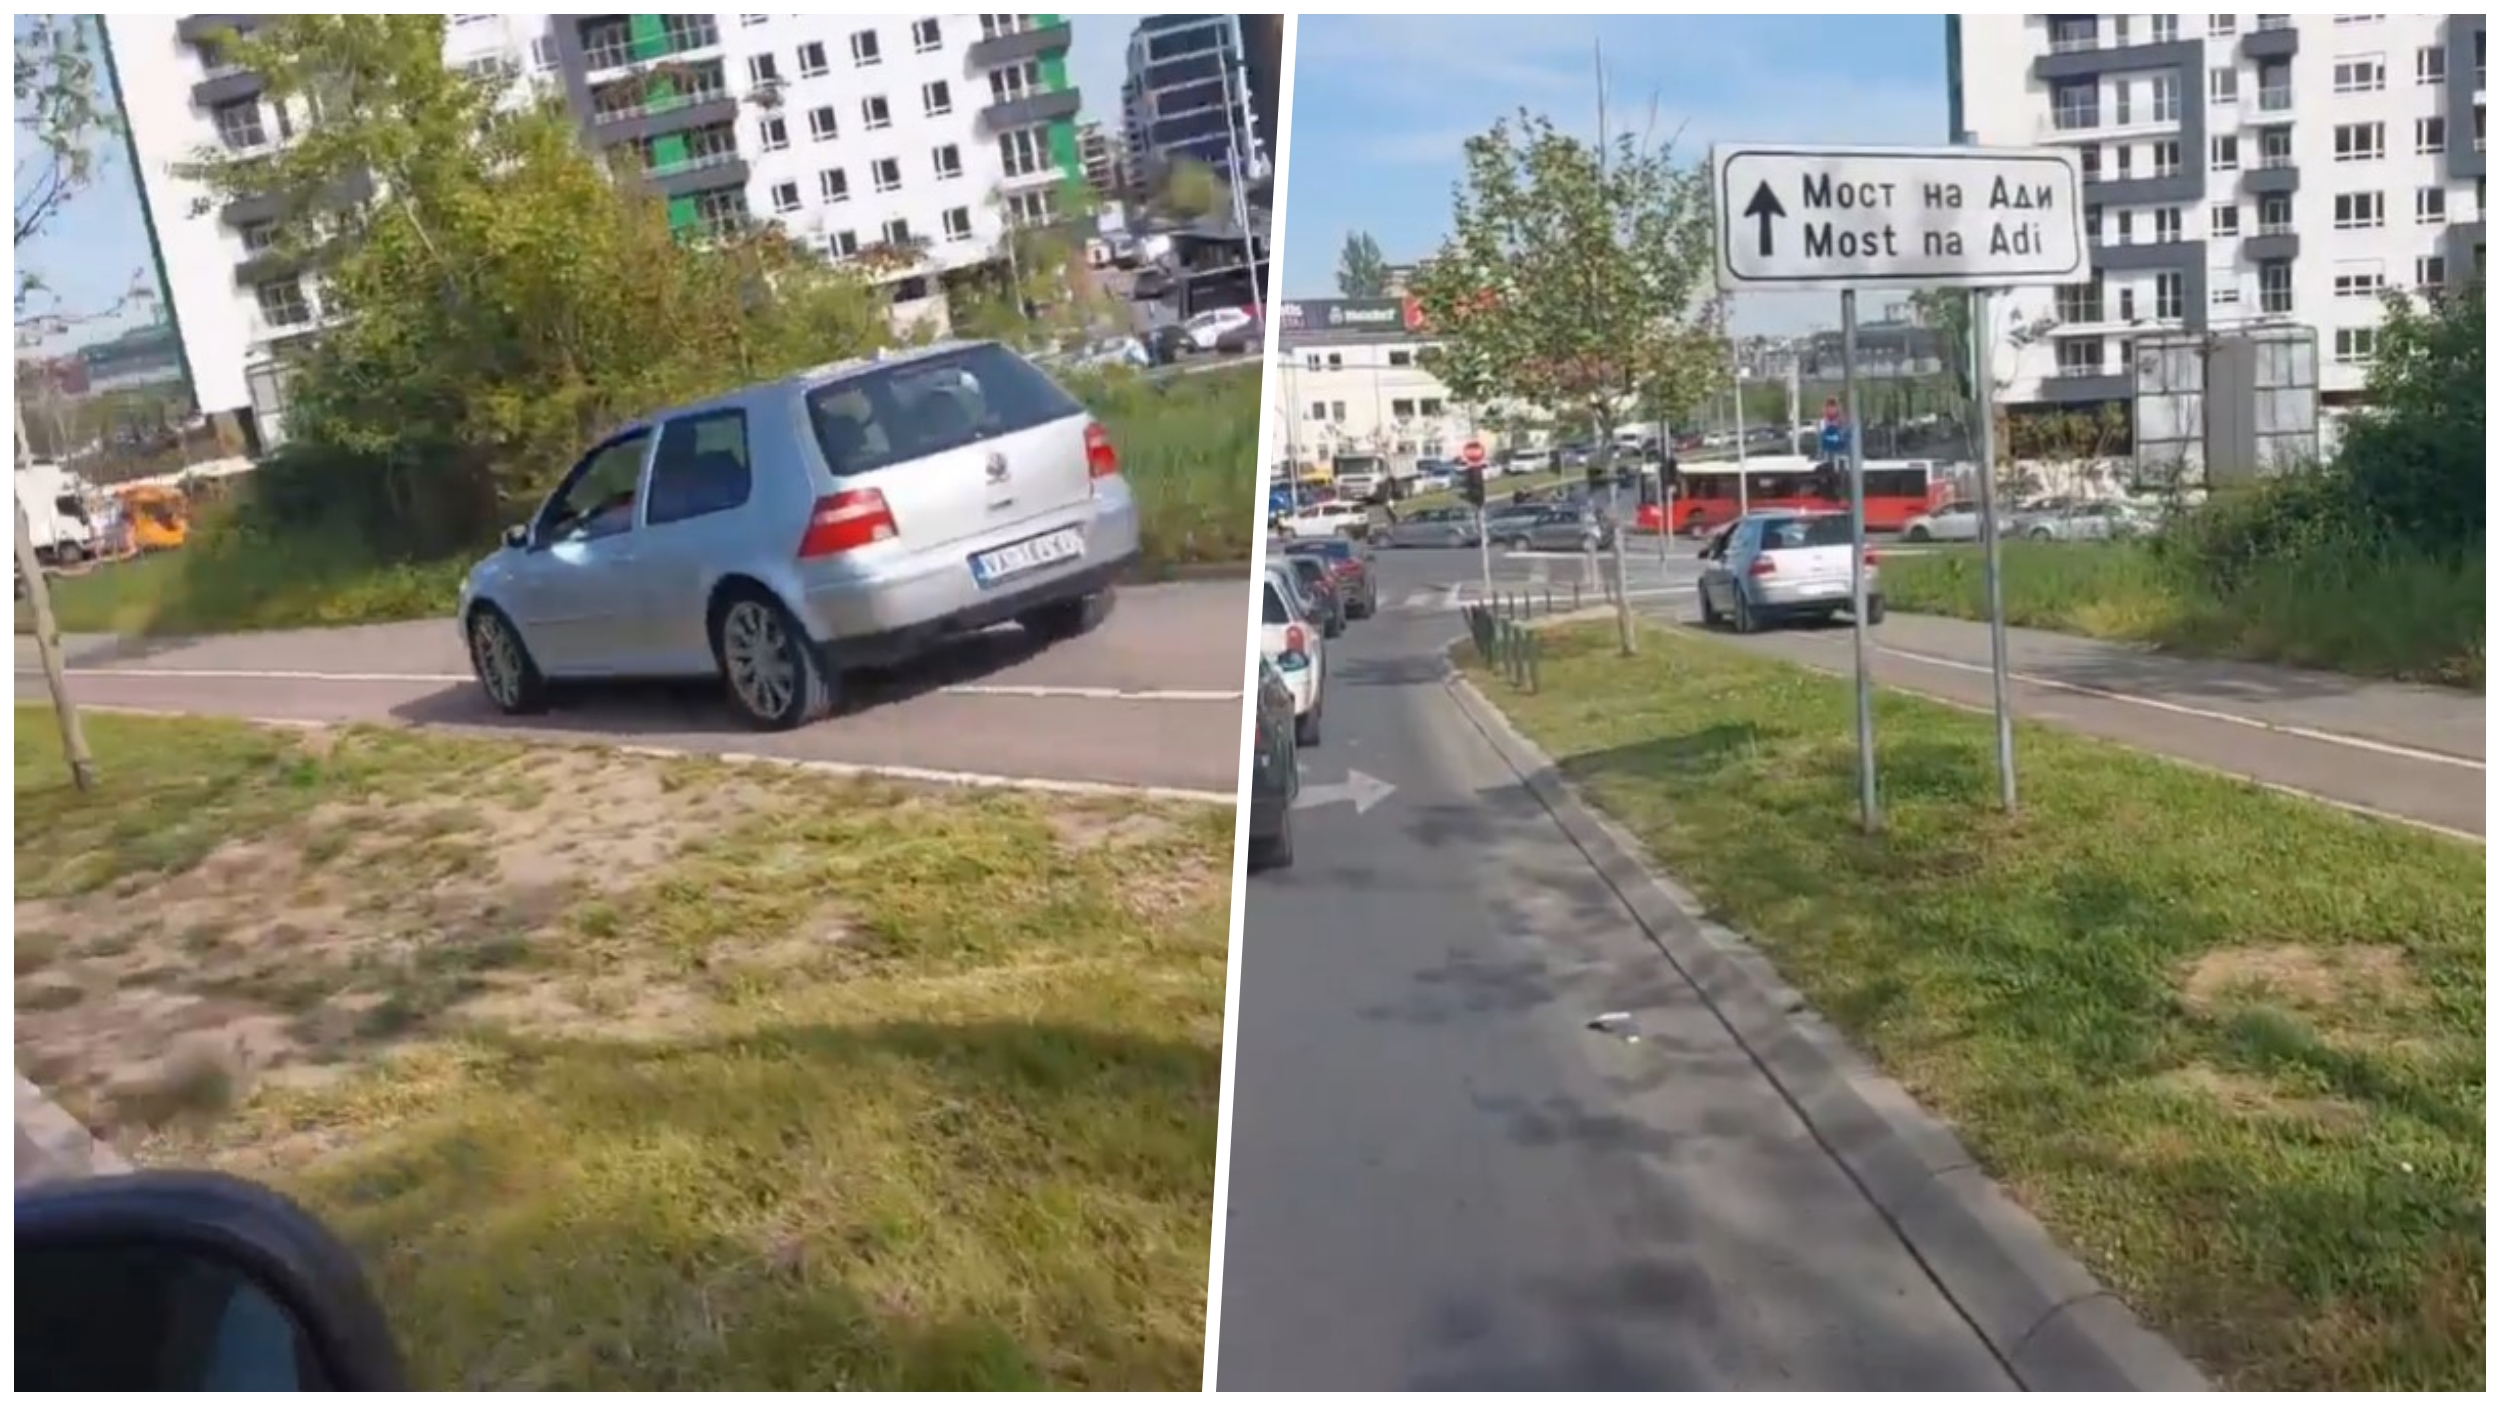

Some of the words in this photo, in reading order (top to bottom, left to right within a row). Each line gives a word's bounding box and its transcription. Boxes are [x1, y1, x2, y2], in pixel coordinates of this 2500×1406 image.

[1802, 172, 1896, 209] Мост
[1923, 182, 1963, 209] на
[1989, 175, 2053, 209] Ади
[1804, 222, 1898, 258] Most
[1923, 229, 1963, 256] na
[1989, 221, 2043, 256] Adi
